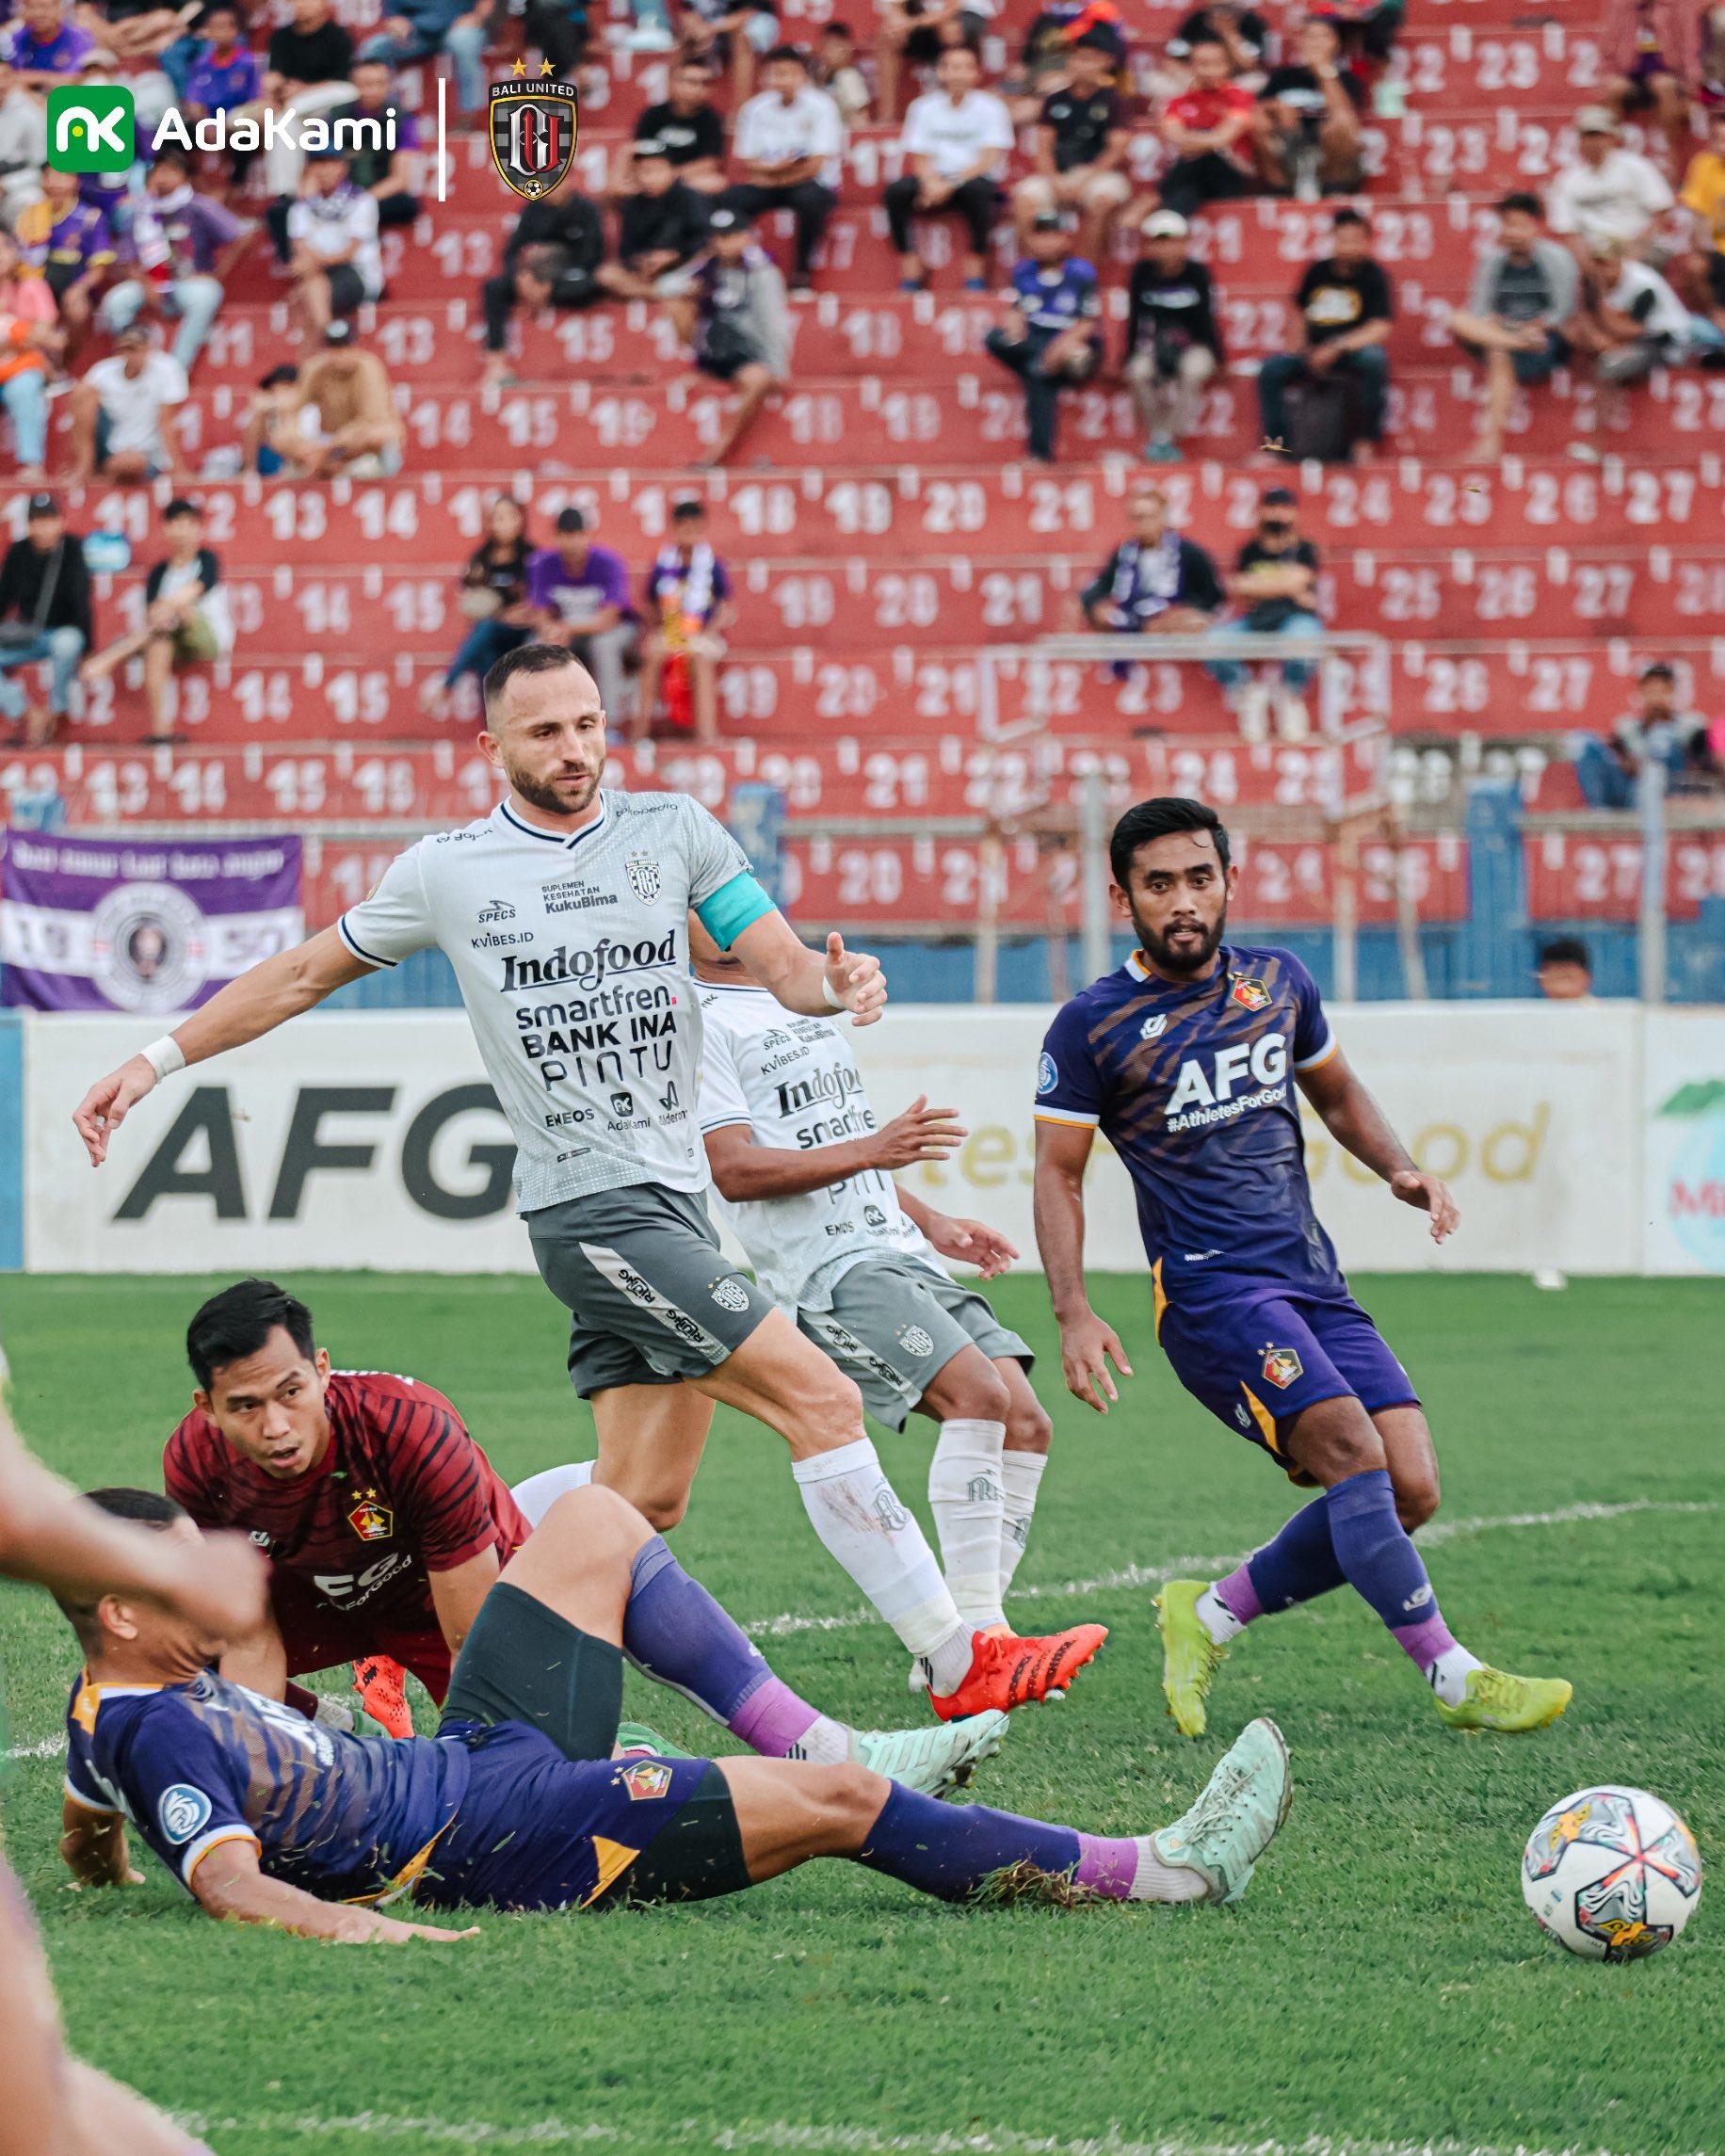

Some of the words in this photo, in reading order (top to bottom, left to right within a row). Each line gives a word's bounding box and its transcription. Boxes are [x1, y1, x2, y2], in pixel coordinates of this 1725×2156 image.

[264, 489, 328, 540] 13
[352, 488, 419, 540] 14
[922, 481, 987, 533] 20
[1029, 480, 1093, 532] 21
[1625, 471, 1695, 524] 27
[873, 574, 939, 627] 20
[980, 572, 1042, 627] 21
[326, 669, 389, 723] 15
[541, 880, 585, 893] SUPLEMEN
[542, 886, 601, 901] KESEHATAN
[838, 849, 902, 905] 20
[478, 908, 517, 924] SPECS
[544, 893, 619, 914] KukuBima
[500, 929, 676, 992] Indofood
[521, 1021, 621, 1058] BANK
[630, 1010, 677, 1043] INA
[764, 1035, 792, 1052] SPECS
[540, 1039, 672, 1091] PINTU
[1164, 1032, 1287, 1116] AFG
[545, 1108, 595, 1128] ENEOS
[607, 1117, 652, 1131] AdaKami
[112, 1084, 518, 1221] AFG
